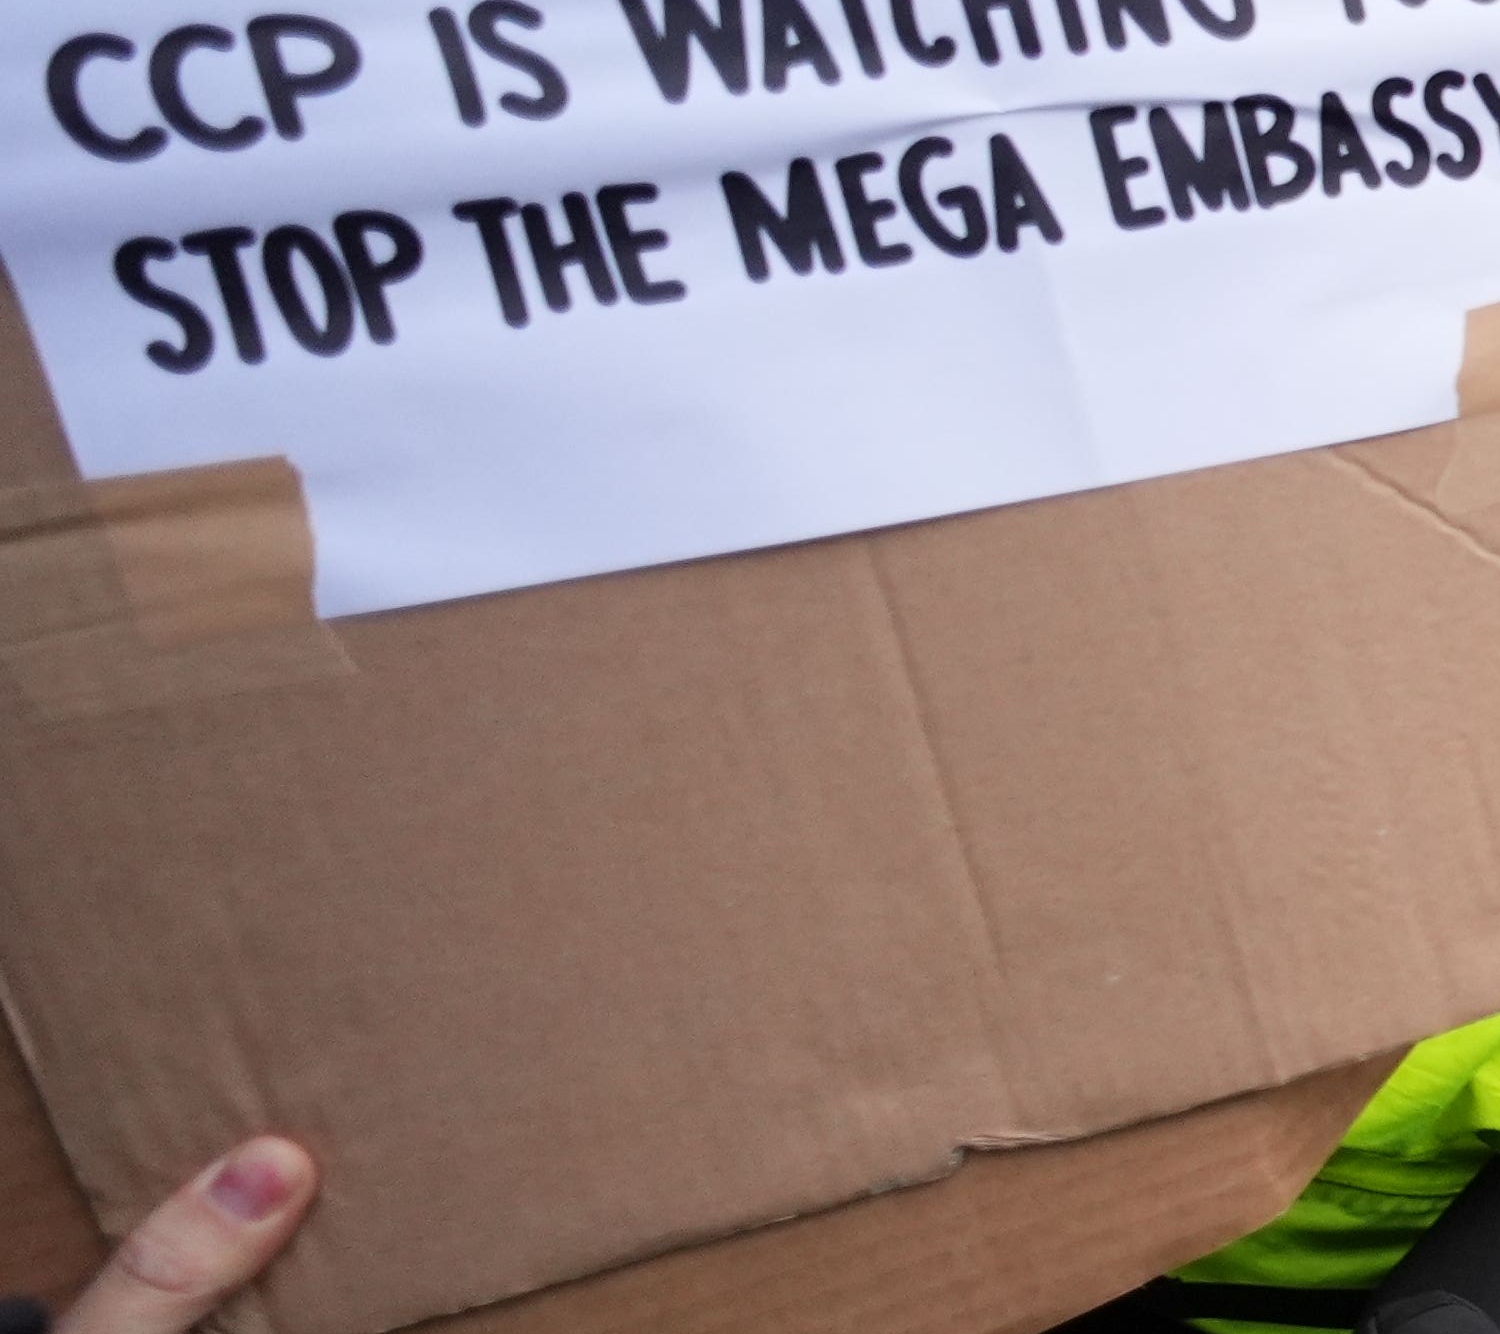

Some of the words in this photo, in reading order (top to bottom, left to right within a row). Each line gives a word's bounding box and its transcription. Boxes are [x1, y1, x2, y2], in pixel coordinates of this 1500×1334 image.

[45, 13, 363, 163] CCP
[113, 209, 426, 376] STOP
[451, 182, 688, 331] THE
[721, 133, 1065, 284] MEGA
